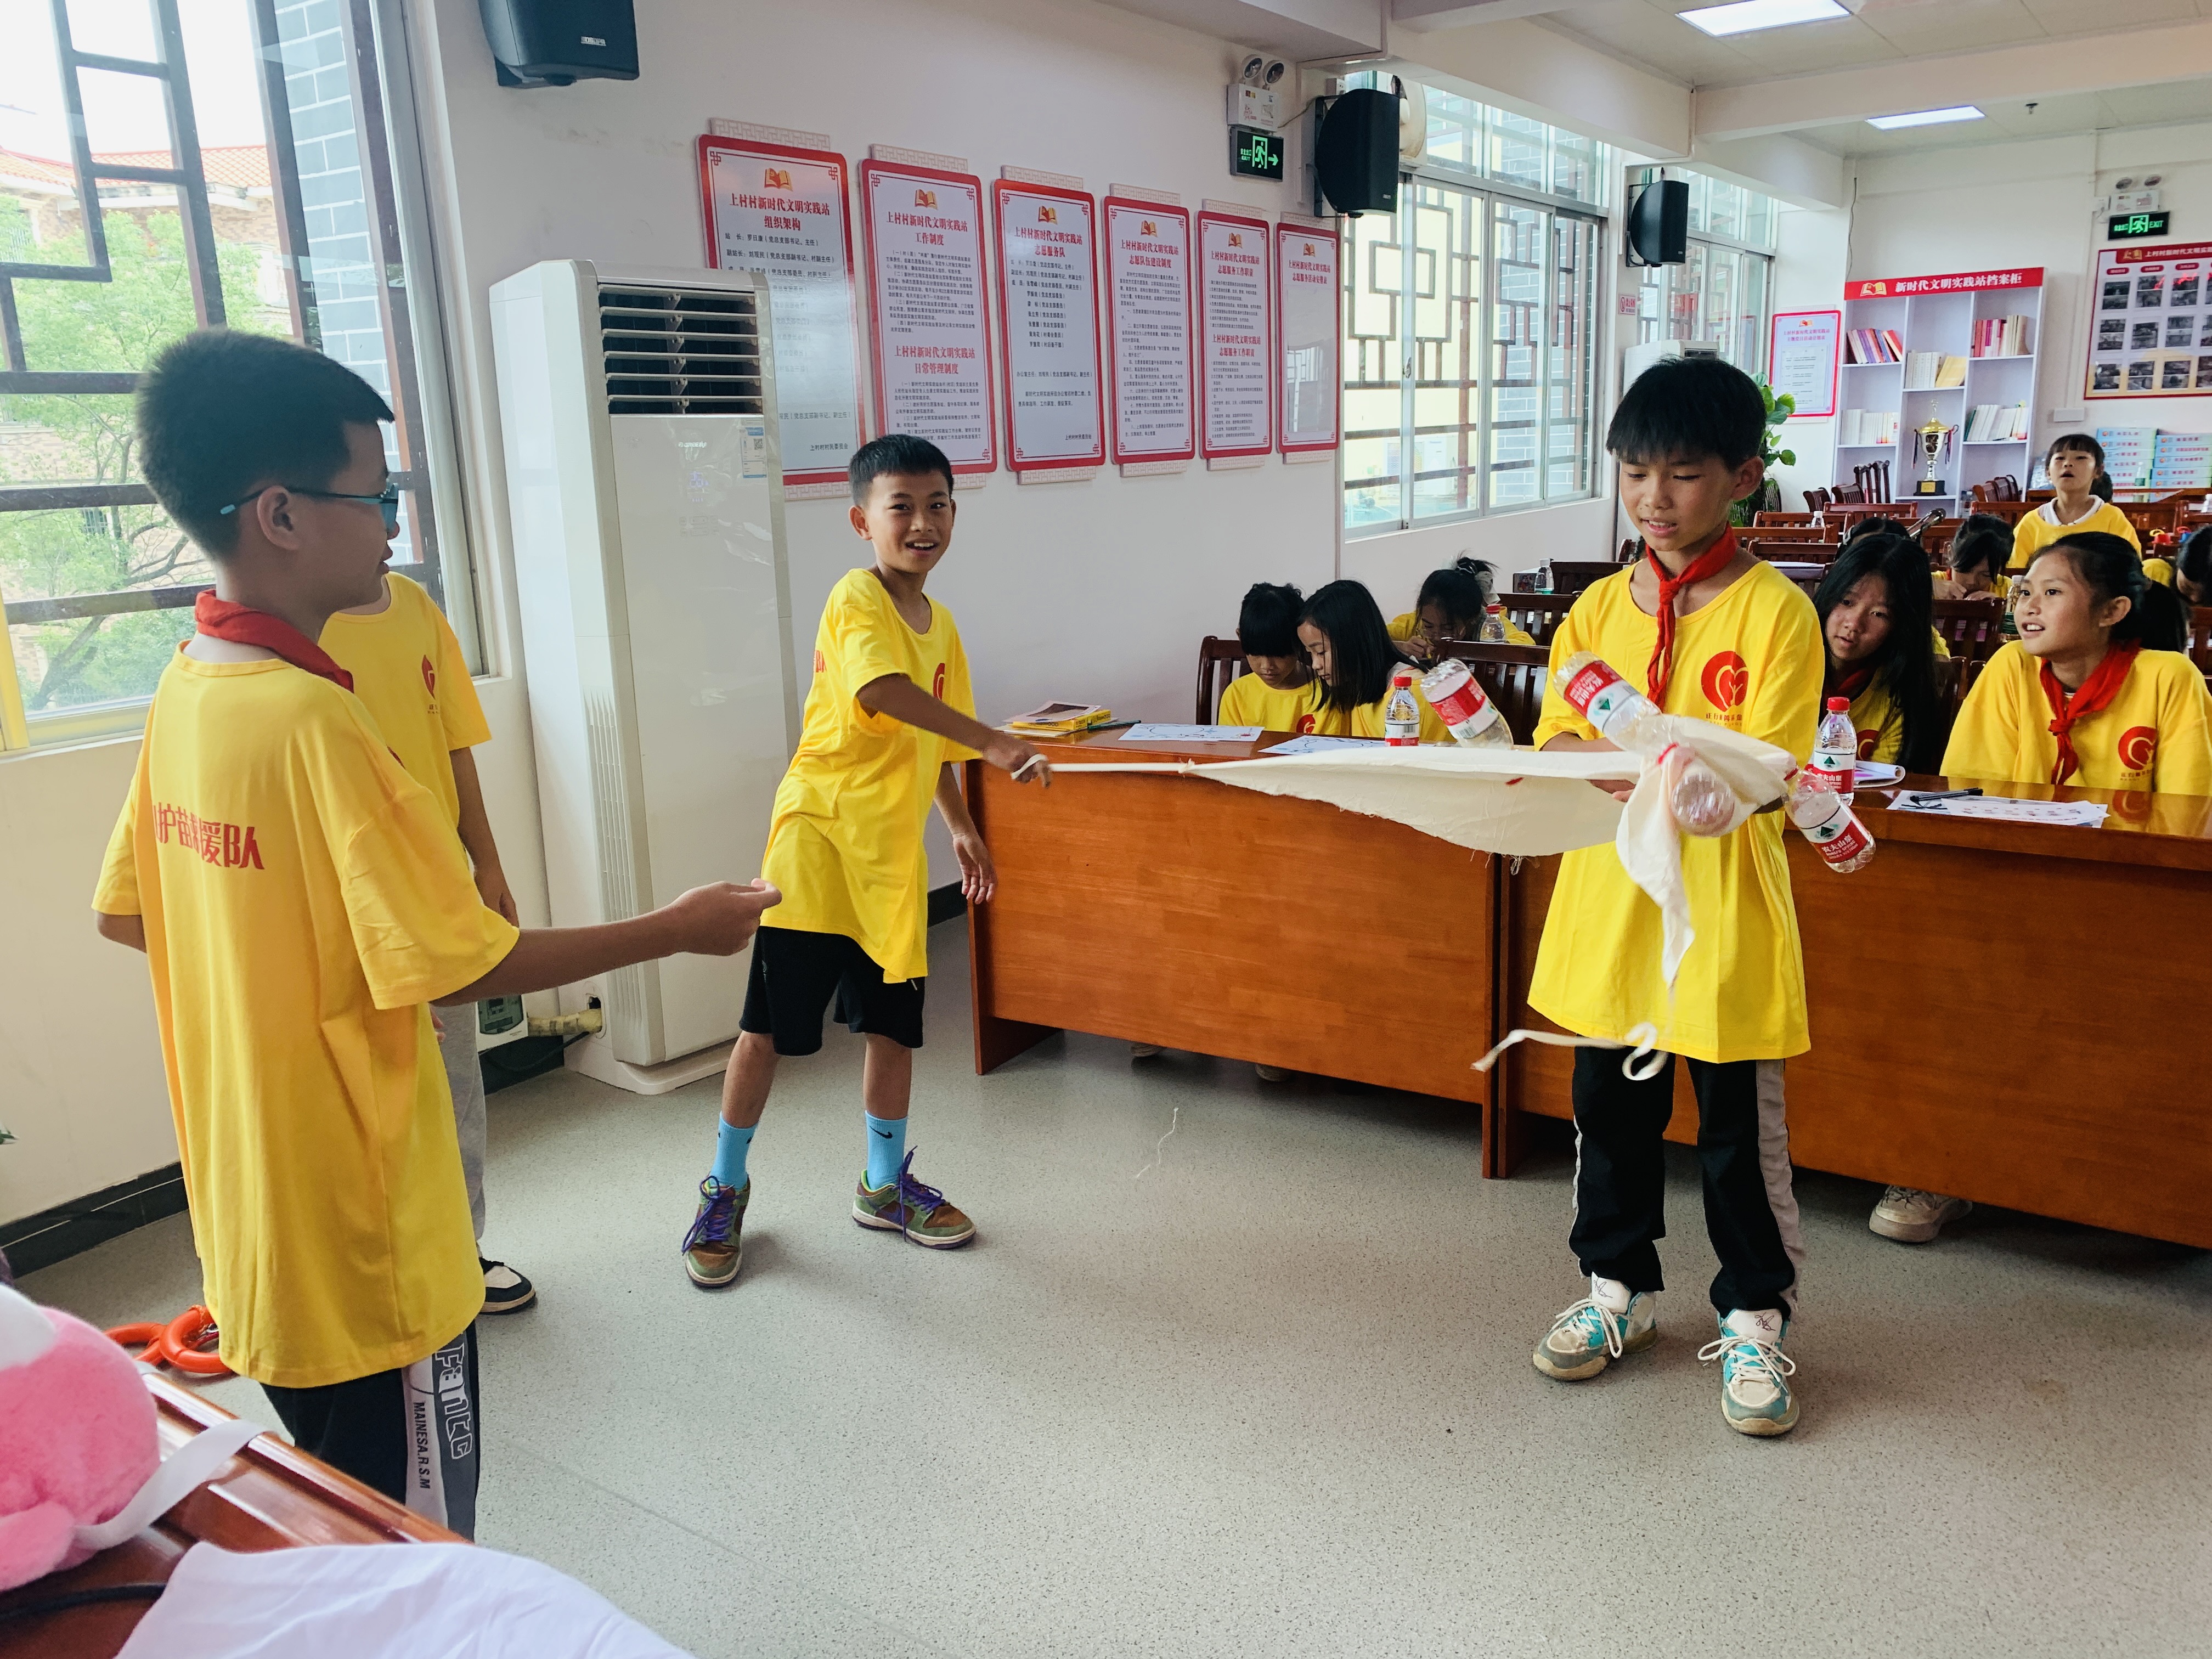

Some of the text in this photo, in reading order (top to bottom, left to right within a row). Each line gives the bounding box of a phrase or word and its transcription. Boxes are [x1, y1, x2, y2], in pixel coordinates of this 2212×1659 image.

[730, 193, 830, 216] 上村村新时代文明实践站
[764, 216, 801, 231] 组织架构
[887, 211, 968, 232] 上村村新时代文明实践站
[2149, 220, 2164, 228] EXIT
[915, 233, 944, 246] 工作制度
[1014, 227, 1082, 245] 上村村新时代文明实践站
[1034, 244, 1065, 257] 志愿服务队
[1120, 239, 1178, 255] 上村村新时代文明实践站
[1129, 255, 1171, 268] 志愿队伍建设制度
[1211, 250, 1260, 265] 上村村新时代文明实践站
[1895, 272, 2023, 293] 新时代文明实践站档案柜
[1212, 334, 1261, 345] 上村村新时代文明实践站
[895, 346, 975, 359] 上村村新时代文明实践站
[915, 363, 958, 374] 日常管理制度
[1821, 833, 1853, 853] 农夫山泉
